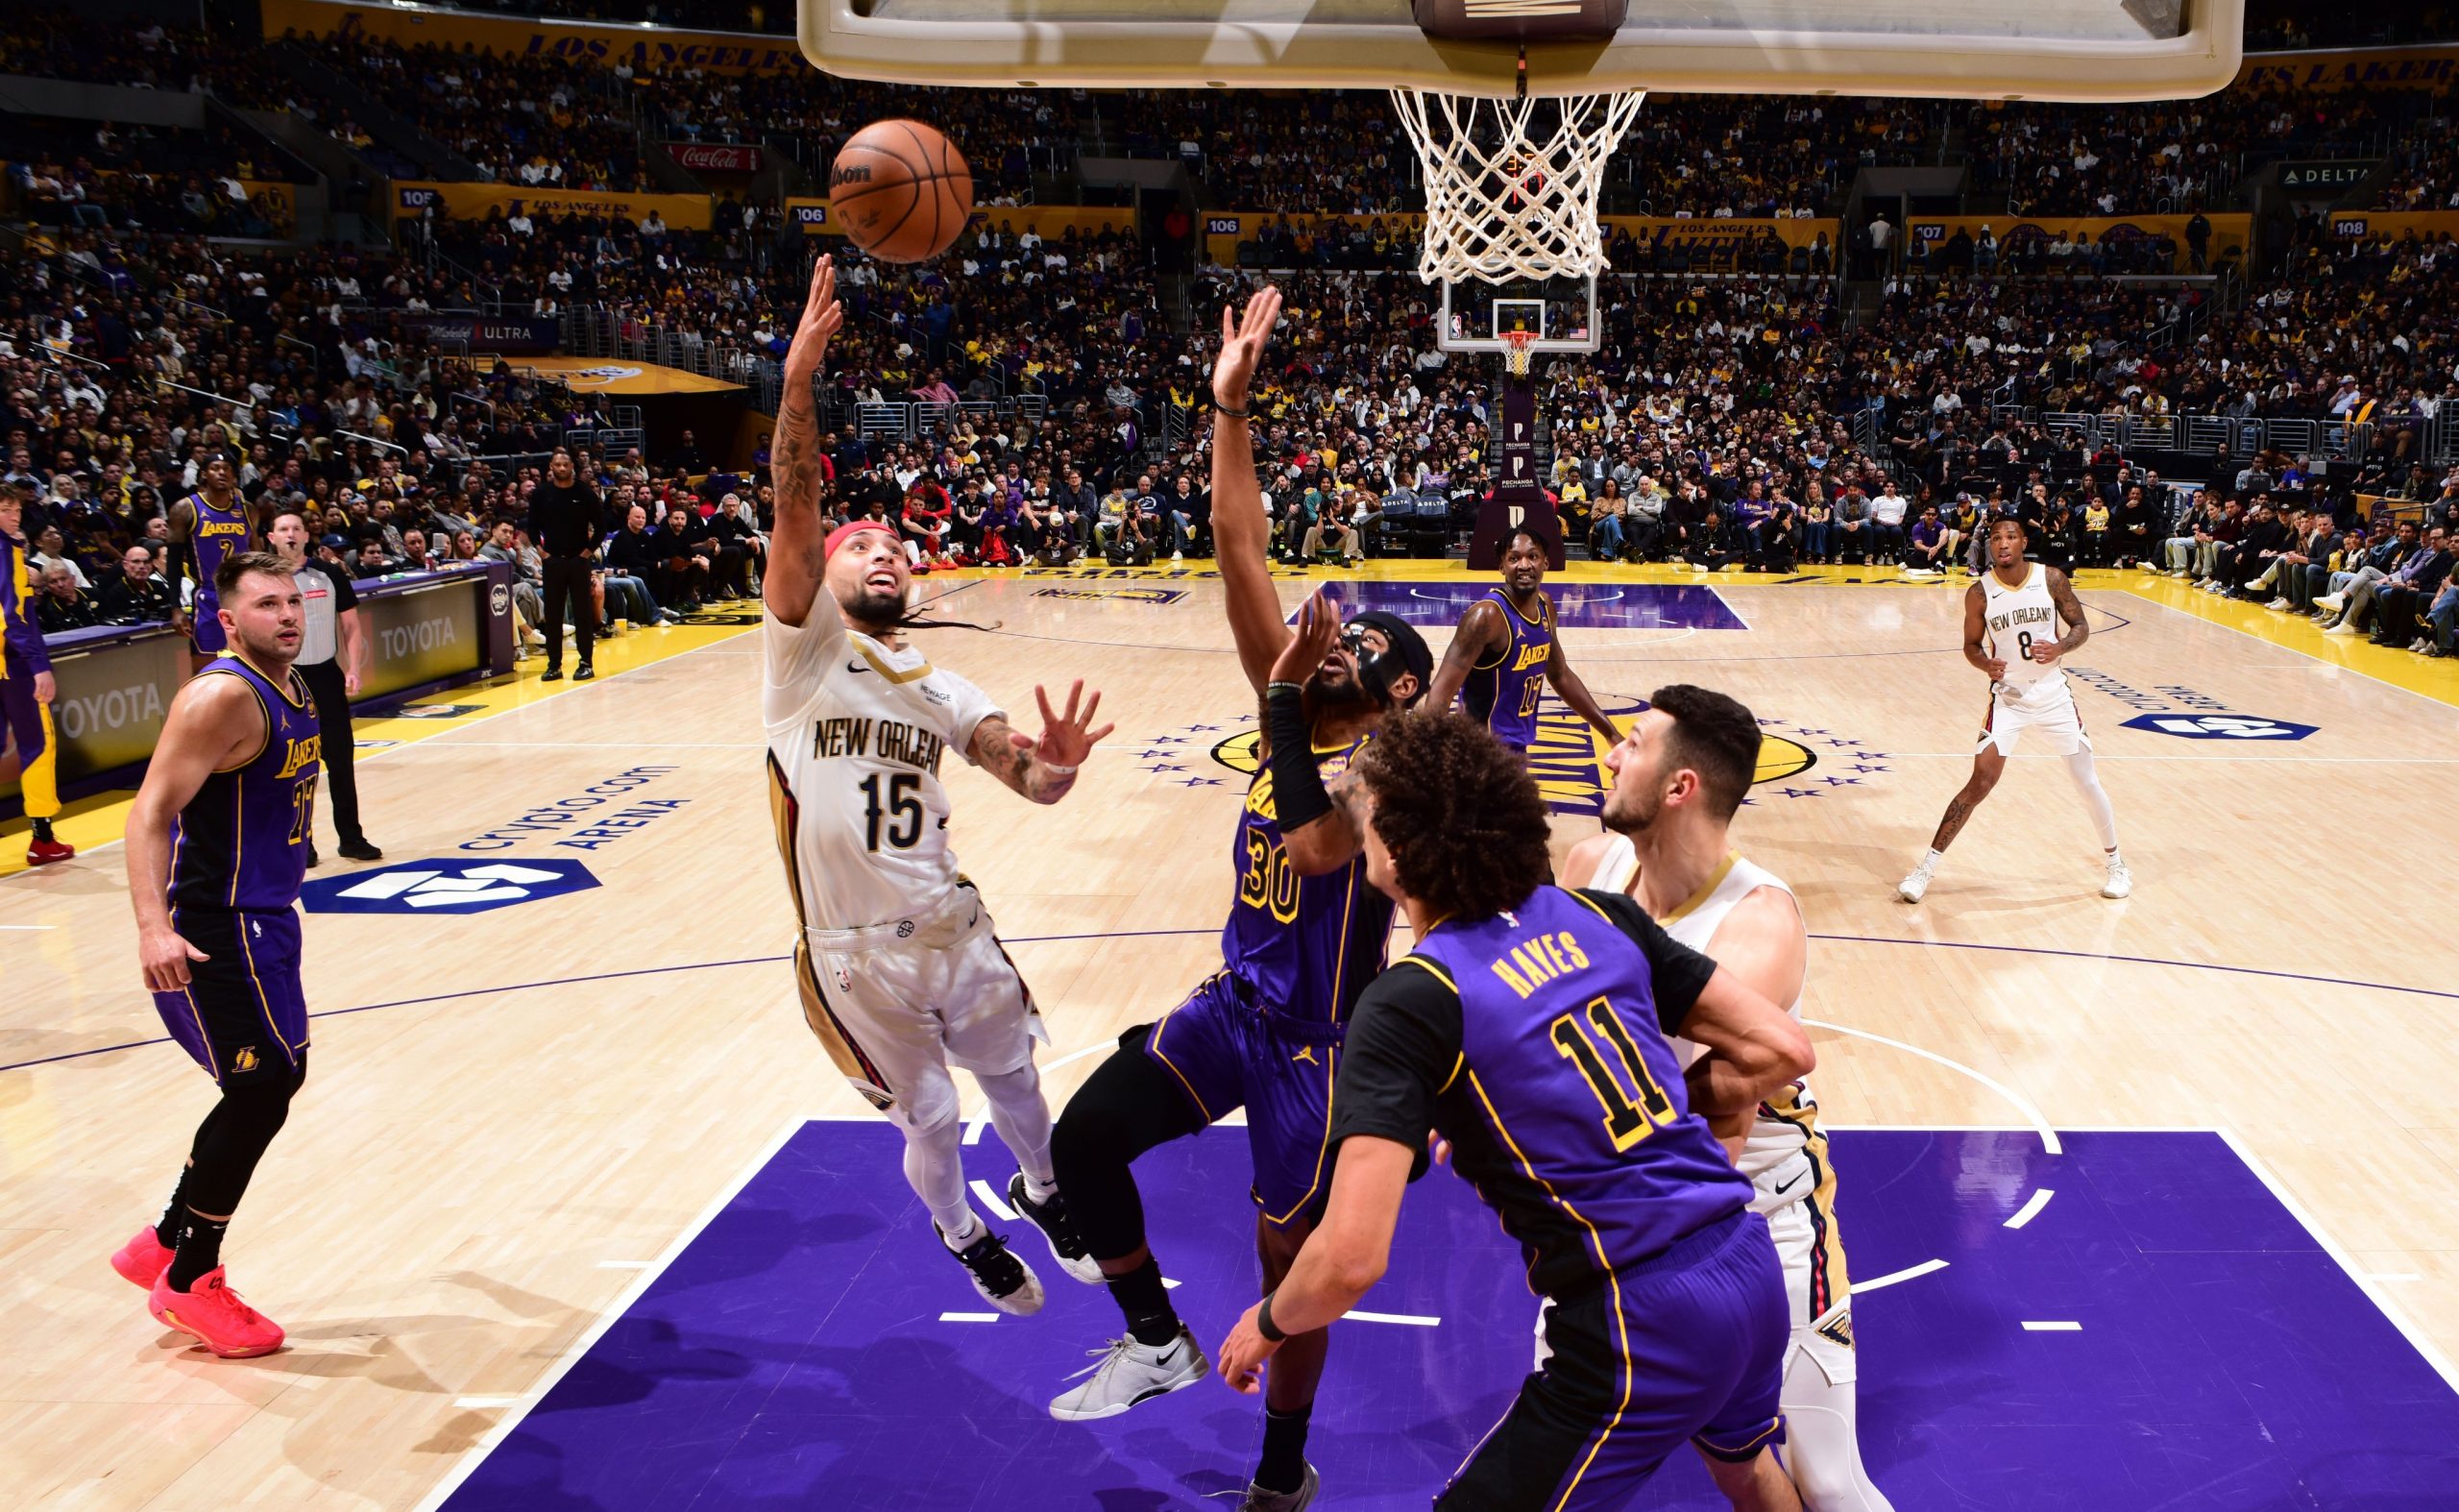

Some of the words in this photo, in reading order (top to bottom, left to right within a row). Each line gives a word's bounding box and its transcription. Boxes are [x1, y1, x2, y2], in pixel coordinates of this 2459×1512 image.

[526, 35, 610, 59] LOS
[2305, 168, 2370, 183] DELTA
[796, 207, 823, 222] 106
[1210, 219, 1236, 232] 106
[1680, 225, 1710, 233] LOS
[2337, 222, 2364, 235] 108
[484, 327, 531, 339] ULTRA
[198, 520, 246, 538] LAKERS
[1989, 613, 2009, 632] NEW
[2012, 607, 2052, 625] ORLEANS
[380, 616, 456, 661] TOYOTA
[2017, 630, 2034, 661] 8
[814, 718, 872, 760] NEW
[877, 719, 944, 780] ORLEAN
[287, 772, 319, 846] 77
[458, 766, 681, 851] crypto.com
[860, 772, 925, 853] 15
[551, 799, 693, 851] ARENA
[1240, 825, 1302, 925] 30
[1491, 931, 1591, 1000] HAYES
[1549, 995, 1678, 1154] 11
